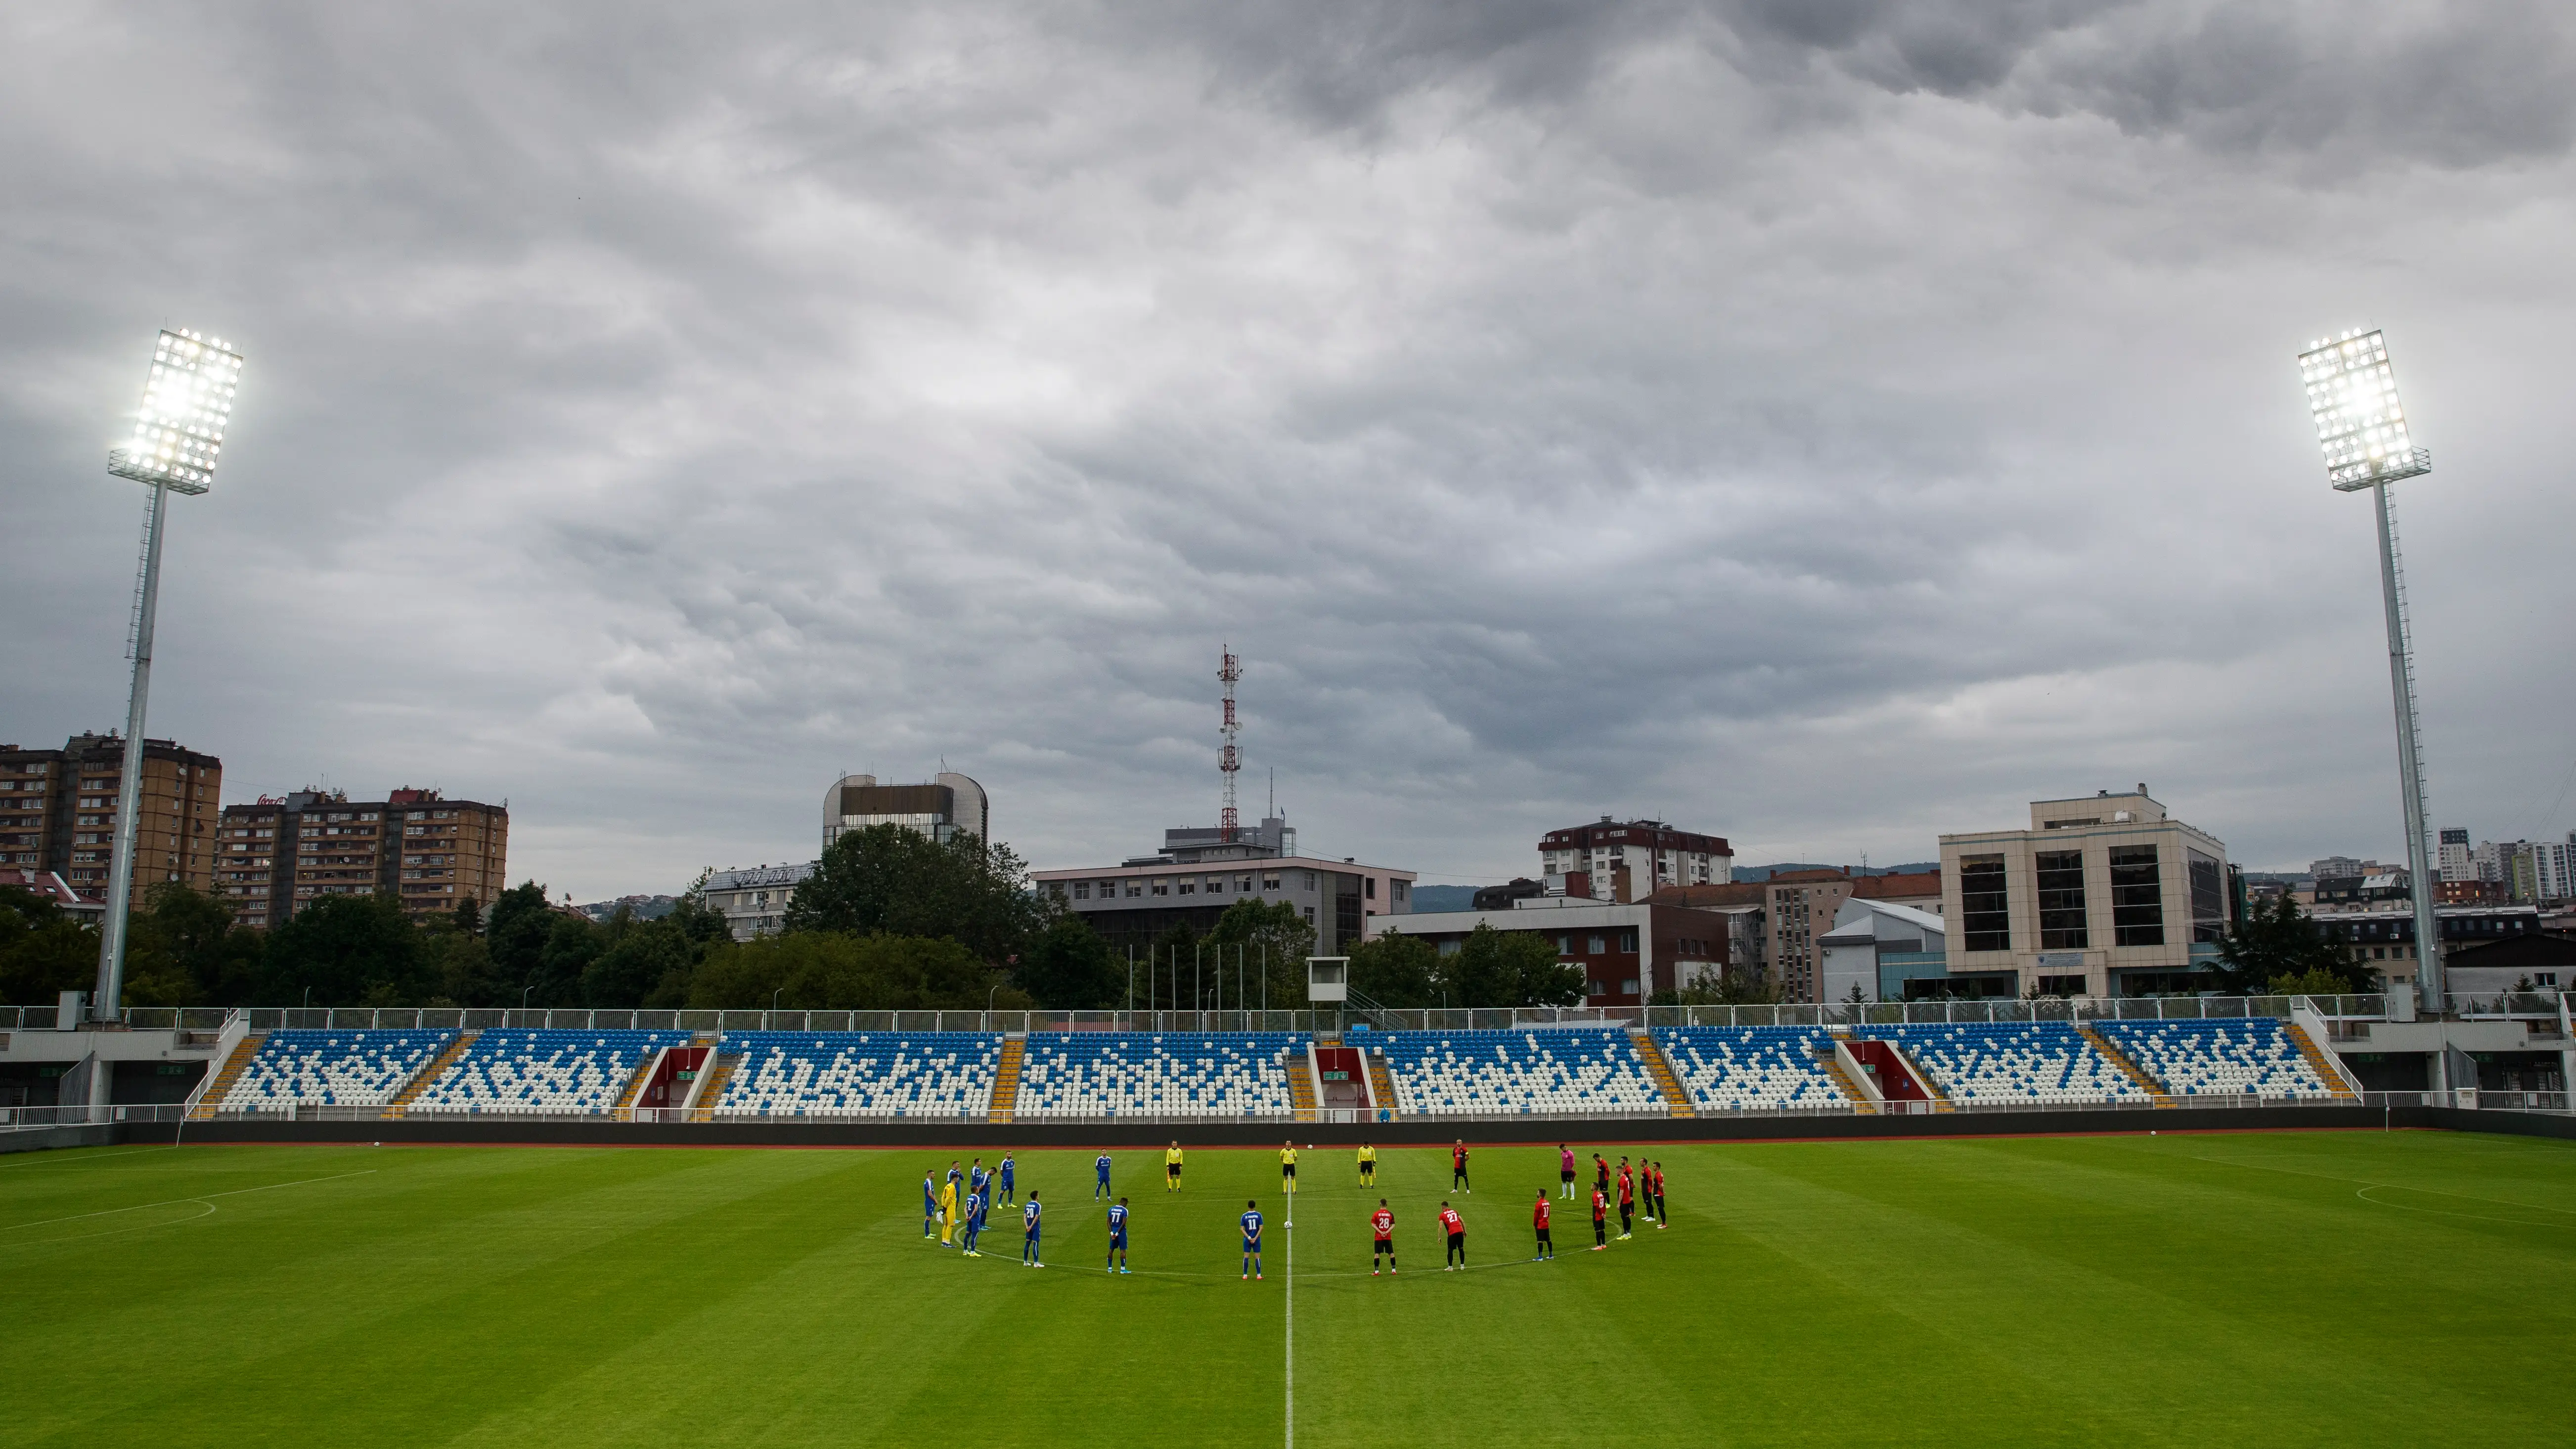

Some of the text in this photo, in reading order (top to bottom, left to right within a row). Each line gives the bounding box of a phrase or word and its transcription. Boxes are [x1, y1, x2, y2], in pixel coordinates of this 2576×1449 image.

[257, 793, 287, 805] Coca-C
[967, 1201, 972, 1211] 2
[1026, 1208, 1034, 1218] 20
[1111, 1212, 1121, 1223] 77
[1447, 1212, 1458, 1223] 27
[1248, 1219, 1256, 1230] 11
[1379, 1218, 1389, 1229] 28
